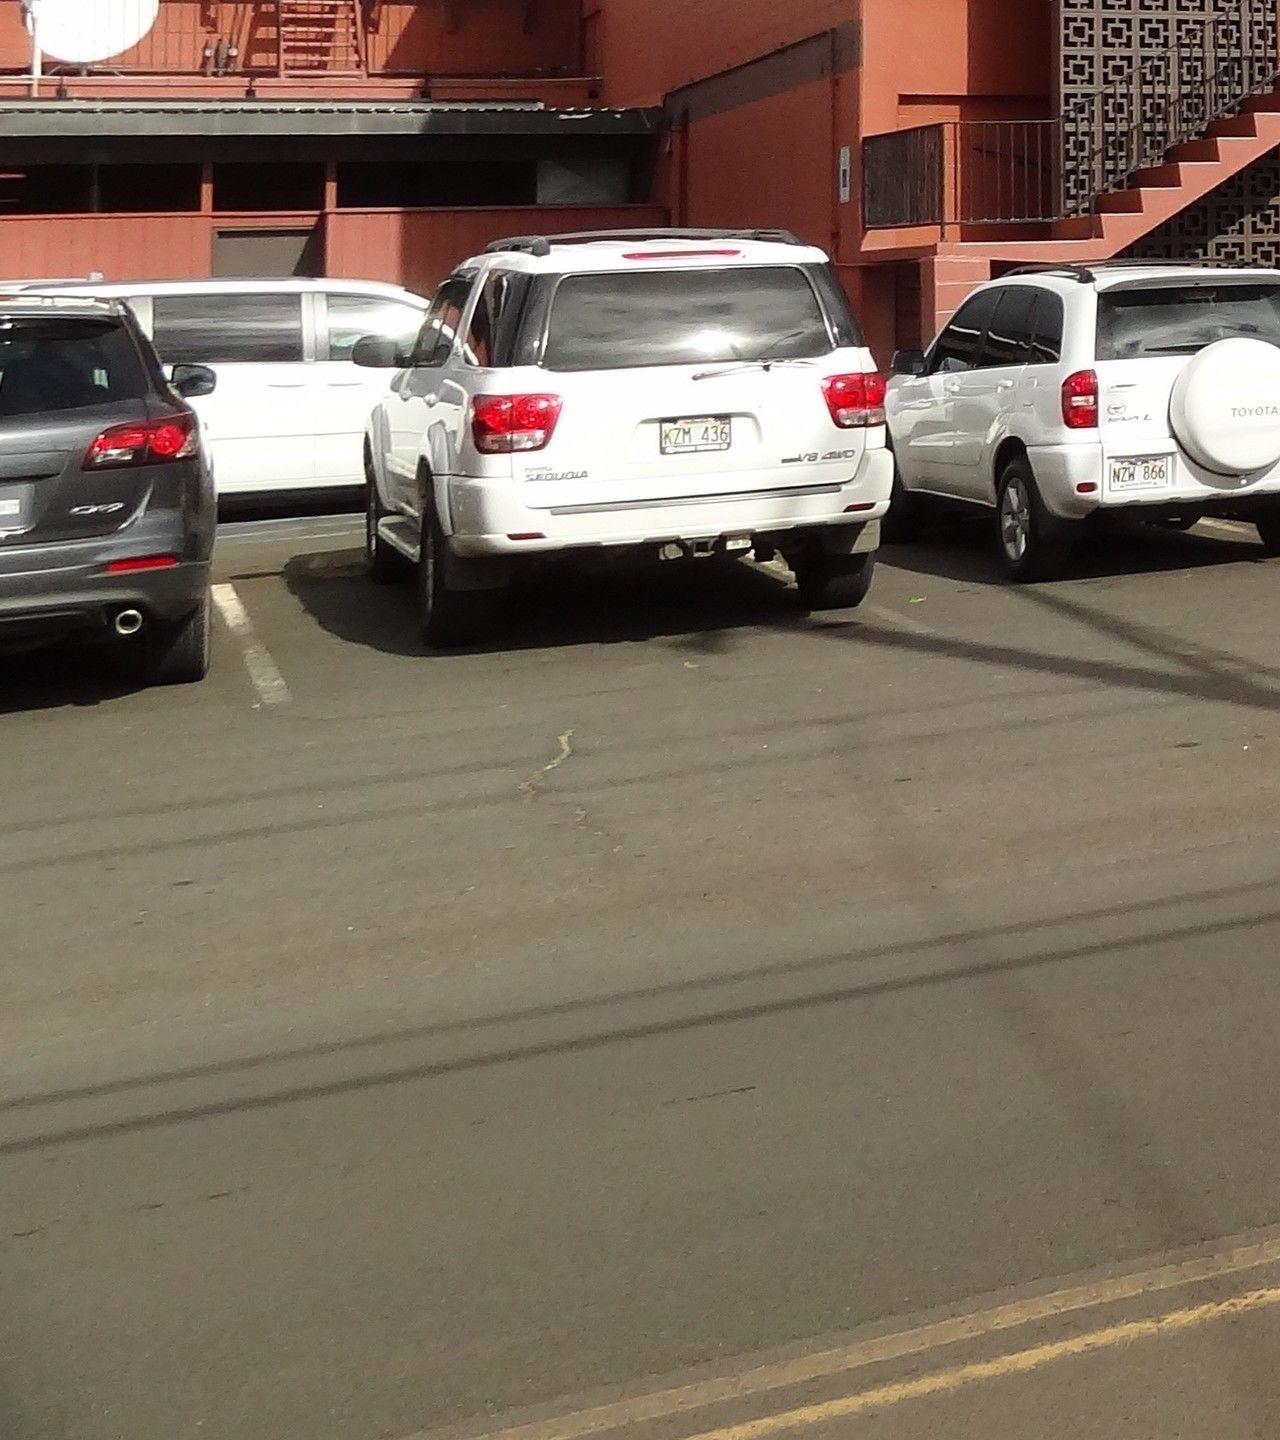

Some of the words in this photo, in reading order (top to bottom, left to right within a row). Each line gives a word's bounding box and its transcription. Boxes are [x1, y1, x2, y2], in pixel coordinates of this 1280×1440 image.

[1231, 406, 1278, 417] TOYOTA
[663, 427, 692, 446] KZM
[701, 425, 728, 442] 436
[524, 470, 588, 482] SEQUOIA
[1143, 464, 1165, 480] 866
